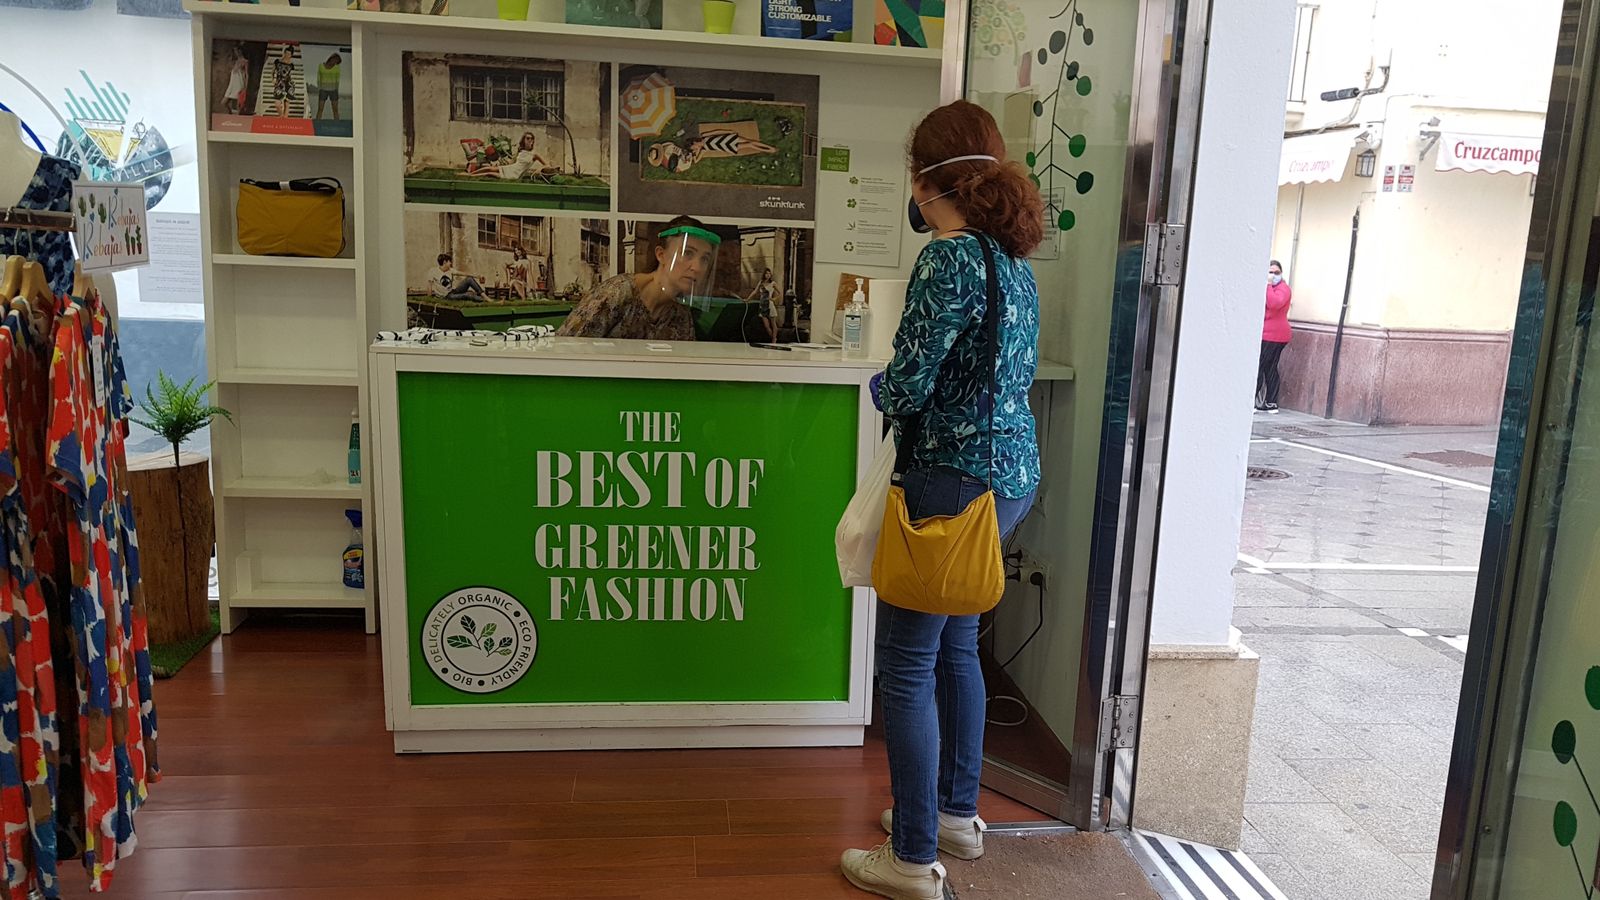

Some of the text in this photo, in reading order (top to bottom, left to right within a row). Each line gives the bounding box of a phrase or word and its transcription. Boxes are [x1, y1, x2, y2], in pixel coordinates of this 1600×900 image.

[768, 4, 802, 13] STRONG
[768, 12, 832, 23] CUSTOMIZABLE
[108, 192, 140, 233] Rebajas
[759, 200, 806, 209] skunkfunk
[83, 218, 122, 265] Rebajas
[620, 411, 681, 443] THE
[533, 450, 765, 509] BEST OF
[534, 523, 761, 571] GREENER
[547, 576, 748, 621] FASHION
[428, 593, 513, 663] DELICATELY ORGANIC
[491, 620, 532, 686] ECO FRIENDLY
[452, 673, 473, 686] BIO
